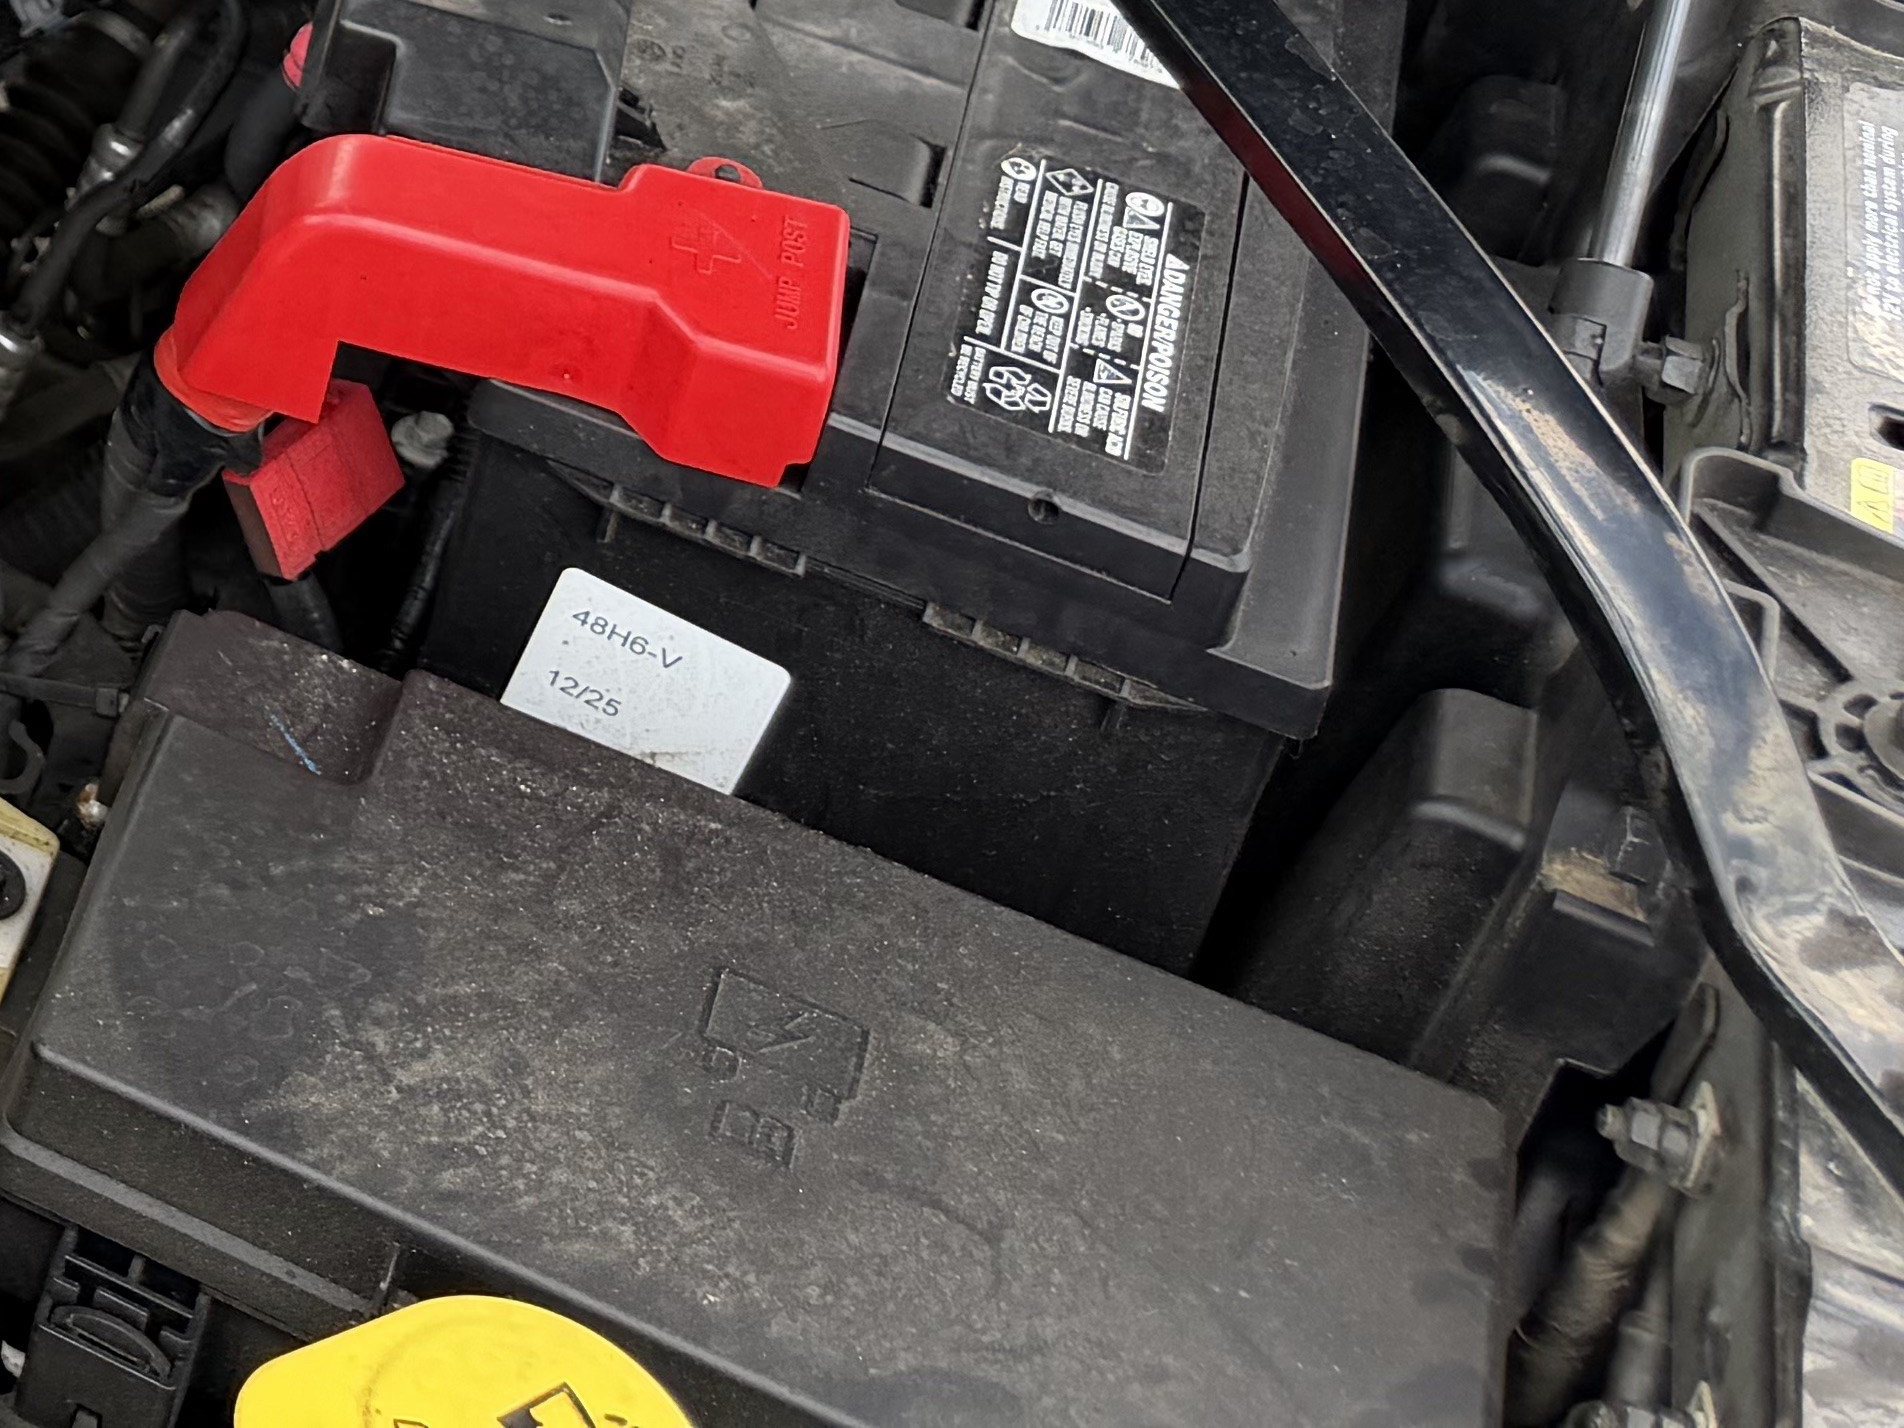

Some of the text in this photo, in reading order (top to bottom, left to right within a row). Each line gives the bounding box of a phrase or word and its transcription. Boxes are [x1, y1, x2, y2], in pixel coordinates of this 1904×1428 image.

[1878, 126, 1899, 165] during
[1860, 169, 1878, 198] than
[1882, 166, 1901, 212] system
[1864, 200, 1878, 233] more
[1862, 233, 1885, 271] apply
[1880, 212, 1900, 275] electrical
[774, 215, 808, 330] JUMP POST
[1140, 267, 1187, 414] DANGER/POISON
[572, 610, 683, 669] 48H6-V
[548, 670, 621, 718] 12/25
